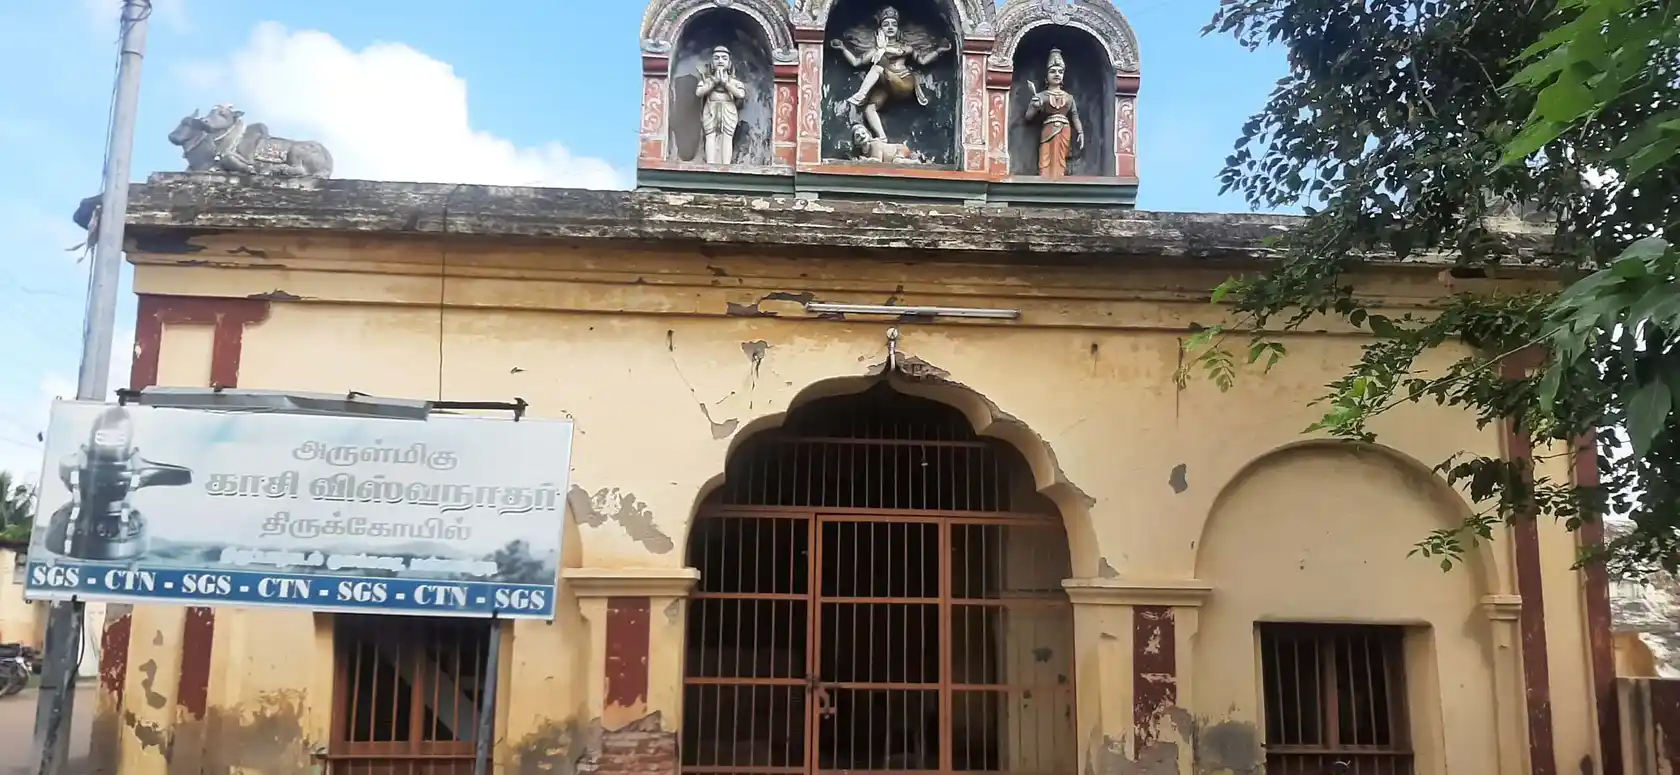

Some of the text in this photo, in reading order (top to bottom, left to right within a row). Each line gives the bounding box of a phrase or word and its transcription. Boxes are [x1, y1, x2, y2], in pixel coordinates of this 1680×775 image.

[292, 438, 458, 471] அருள்மிகு
[205, 470, 560, 515] காசி விஸ்வநாதர்
[258, 510, 472, 541] திருக்கோயில்
[31, 566, 80, 587] SGS
[104, 569, 157, 592] CTN
[182, 573, 232, 595] SGS
[257, 577, 313, 599] CTN
[337, 581, 388, 603] SGS
[413, 584, 469, 606] CTN
[494, 588, 546, 610] SGS
